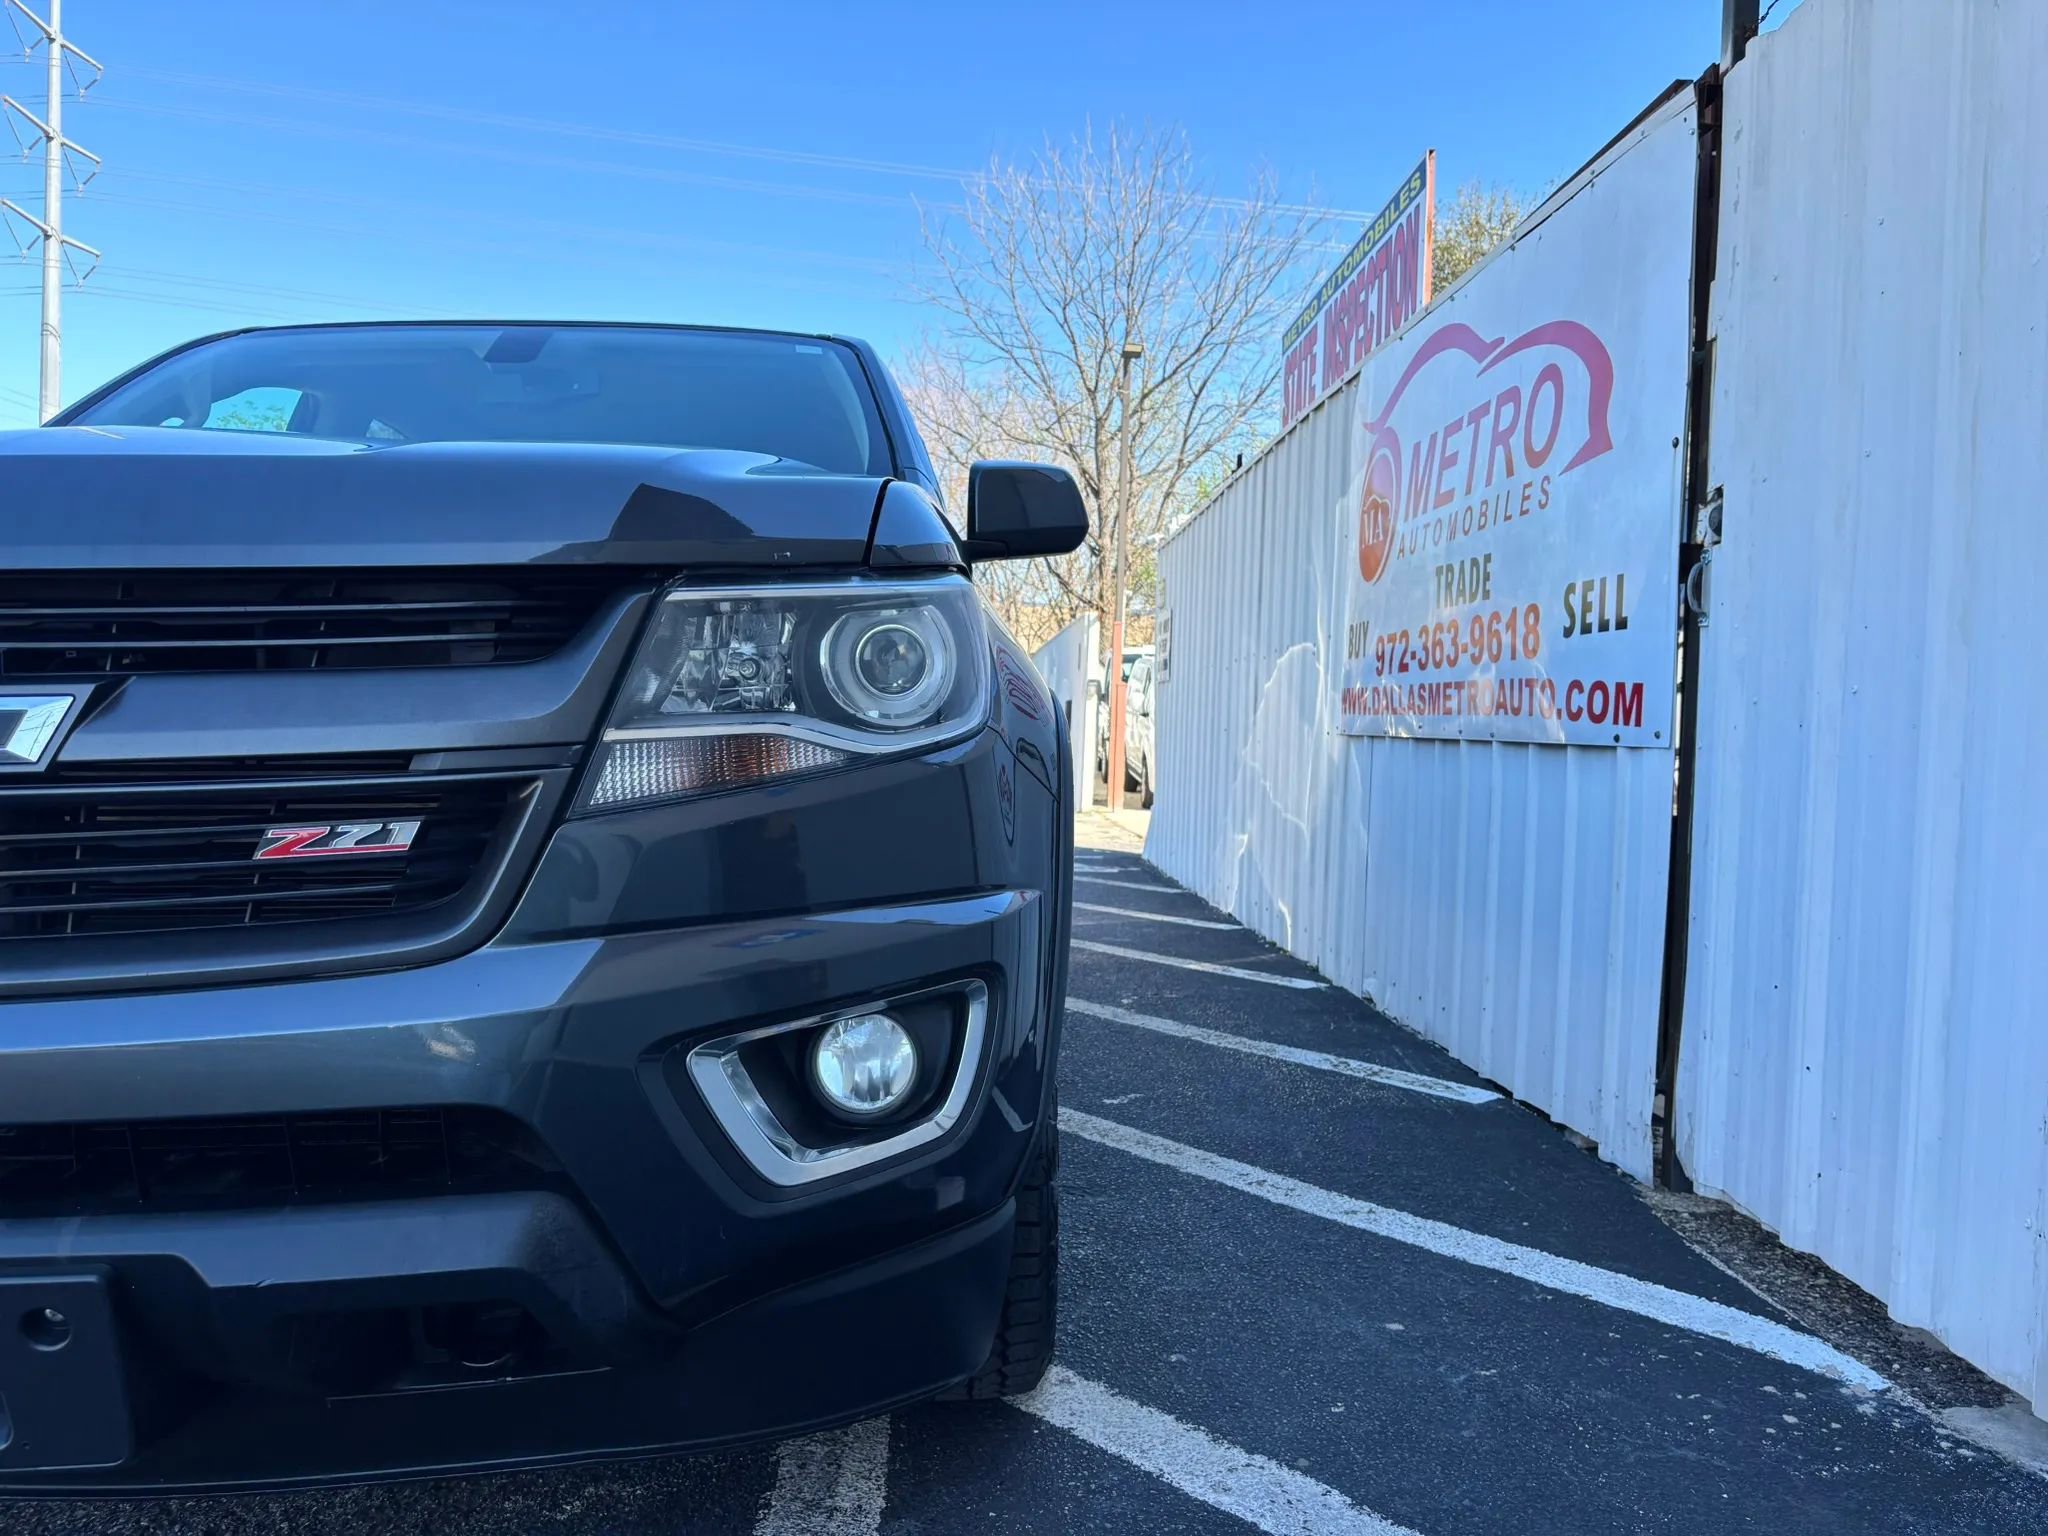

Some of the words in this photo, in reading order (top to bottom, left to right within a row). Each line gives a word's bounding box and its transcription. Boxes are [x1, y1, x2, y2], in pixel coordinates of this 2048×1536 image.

[1283, 300, 1318, 350] METRO
[1320, 171, 1421, 302] AUTOMOBILES
[1282, 321, 1318, 429] STATE
[1322, 202, 1421, 390] INSPECTION
[1403, 363, 1564, 523] METRO
[1397, 475, 1551, 560] AUTOMOBILES
[1435, 553, 1492, 610] TRADE
[1563, 573, 1628, 639] SELL
[1347, 620, 1370, 660] BUY
[1375, 603, 1541, 677] 972-363-9618
[1341, 678, 1644, 728] WWW.DALLASMETROAUTO.COM
[257, 821, 421, 860] Z71
